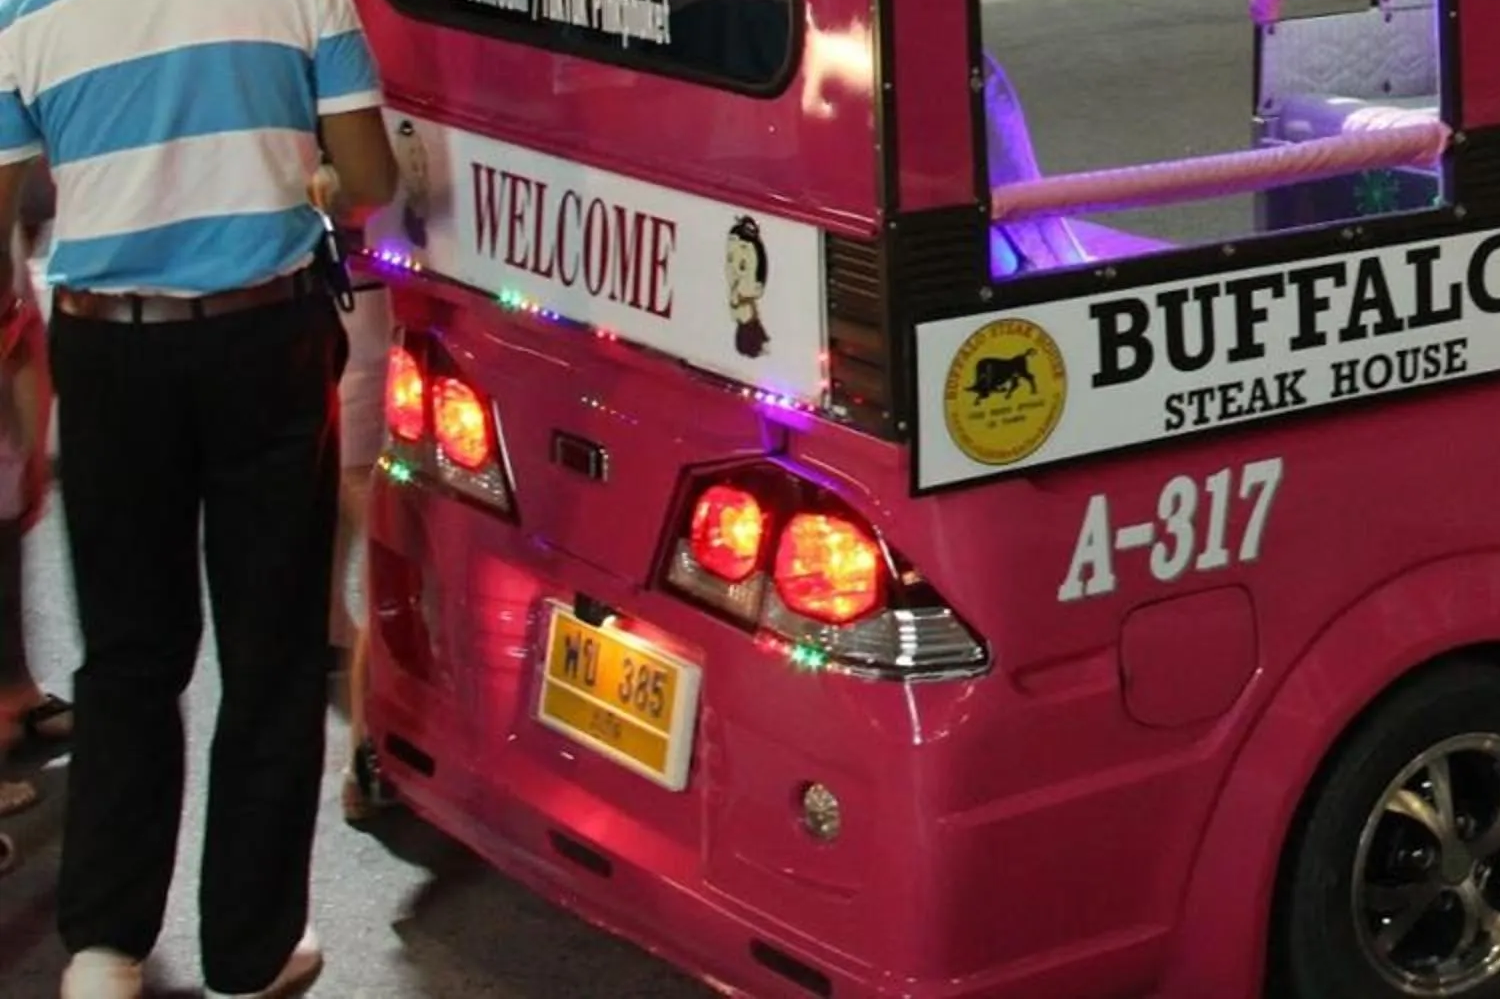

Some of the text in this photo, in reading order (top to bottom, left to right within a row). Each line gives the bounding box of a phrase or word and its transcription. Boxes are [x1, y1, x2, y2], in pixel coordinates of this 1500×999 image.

[470, 161, 678, 320] WELCOME
[1164, 337, 1468, 432] STEAK HOUSE
[1057, 457, 1284, 602] A-317
